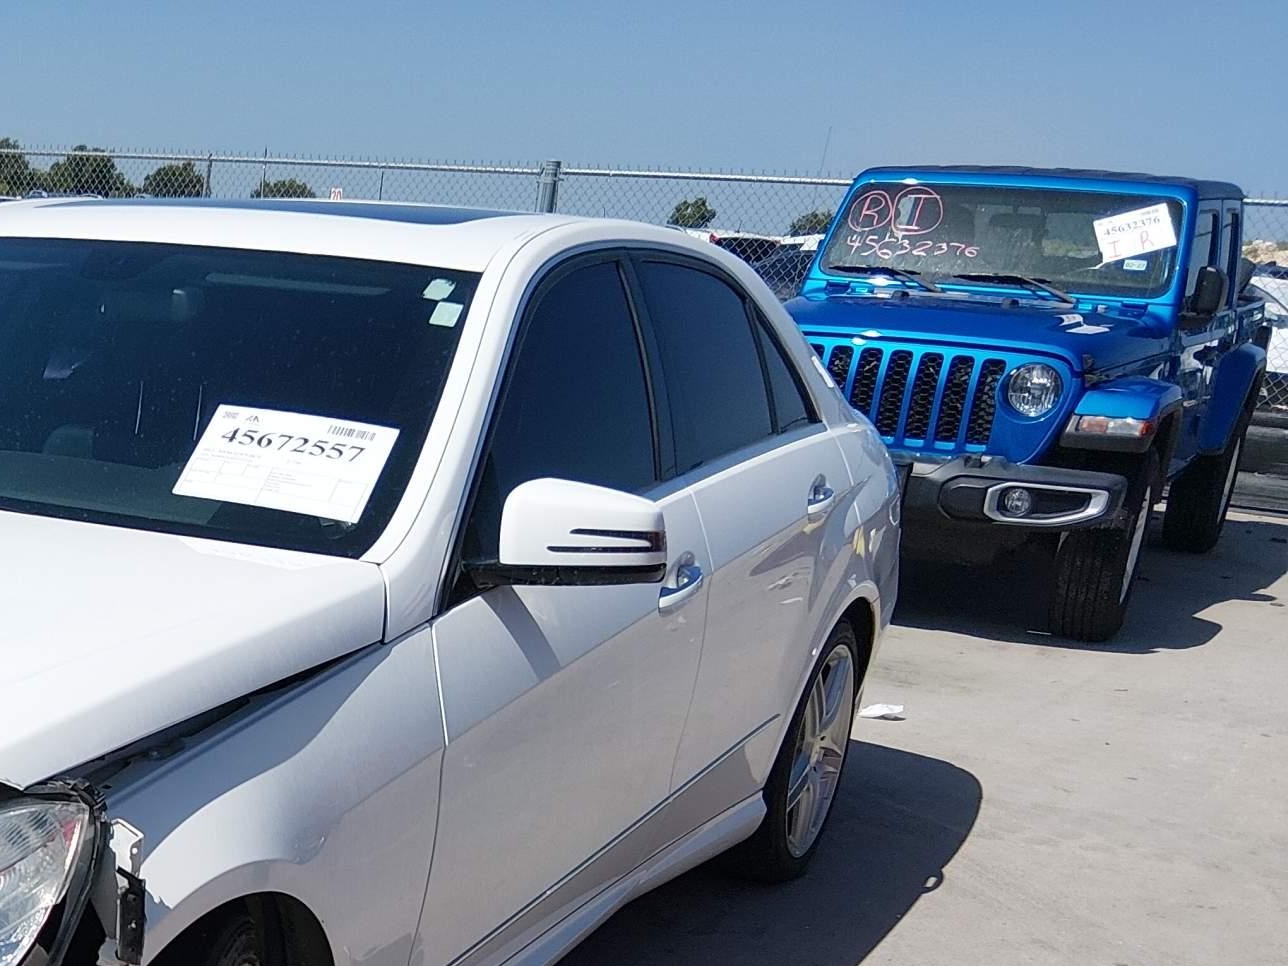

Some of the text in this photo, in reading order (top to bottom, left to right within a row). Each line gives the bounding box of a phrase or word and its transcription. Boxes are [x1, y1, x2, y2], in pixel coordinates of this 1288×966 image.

[857, 193, 941, 230] R I
[1103, 216, 1161, 236] 45632376
[846, 234, 980, 260] 45632376
[1139, 230, 1154, 249] R
[221, 427, 366, 462] 45672557
